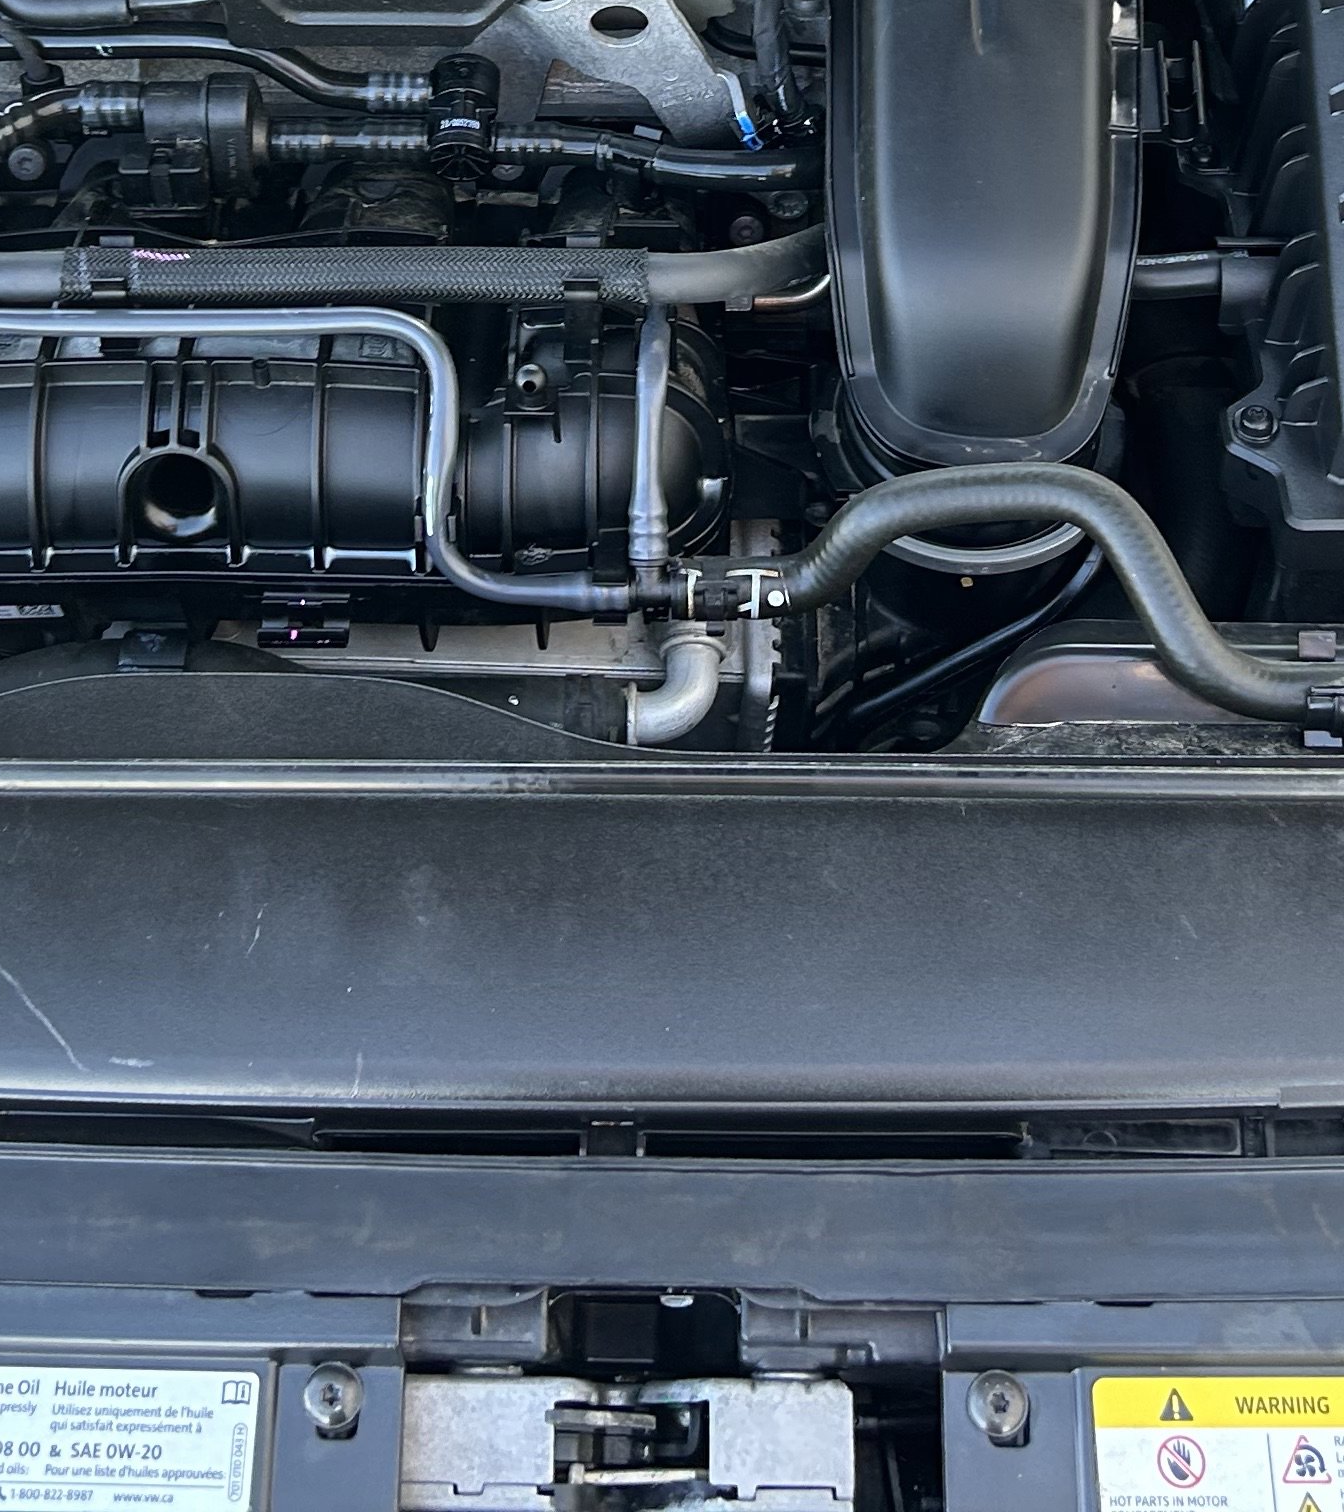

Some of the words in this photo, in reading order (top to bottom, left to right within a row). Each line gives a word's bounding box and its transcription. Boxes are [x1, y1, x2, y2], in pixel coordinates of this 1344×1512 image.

[17, 1379, 41, 1396] Oil
[54, 1380, 95, 1397] Huile
[99, 1384, 158, 1398] moteur
[52, 1403, 92, 1417] Utilisez
[94, 1404, 162, 1419] uniquement
[164, 1406, 179, 1418] de
[181, 1406, 215, 1419] l'huile
[1235, 1395, 1331, 1416] WARNING
[50, 1419, 68, 1433] qui
[70, 1419, 114, 1432] satisfait
[115, 1420, 193, 1434] expressément
[195, 1421, 203, 1434] à
[18, 1441, 42, 1457] 00
[49, 1444, 62, 1458] &
[70, 1442, 102, 1459] SAE
[106, 1442, 163, 1460] 0W-20
[45, 1464, 70, 1477] Pour
[72, 1466, 93, 1477] une
[94, 1465, 116, 1478] liste
[118, 1465, 159, 1479] d'huiles
[113, 1493, 175, 1503] www.vw.ca
[1110, 1495, 1133, 1507] HOT
[1135, 1495, 1170, 1507] PARTS
[1172, 1495, 1185, 1507] IN
[1187, 1495, 1229, 1507] MOTOR
